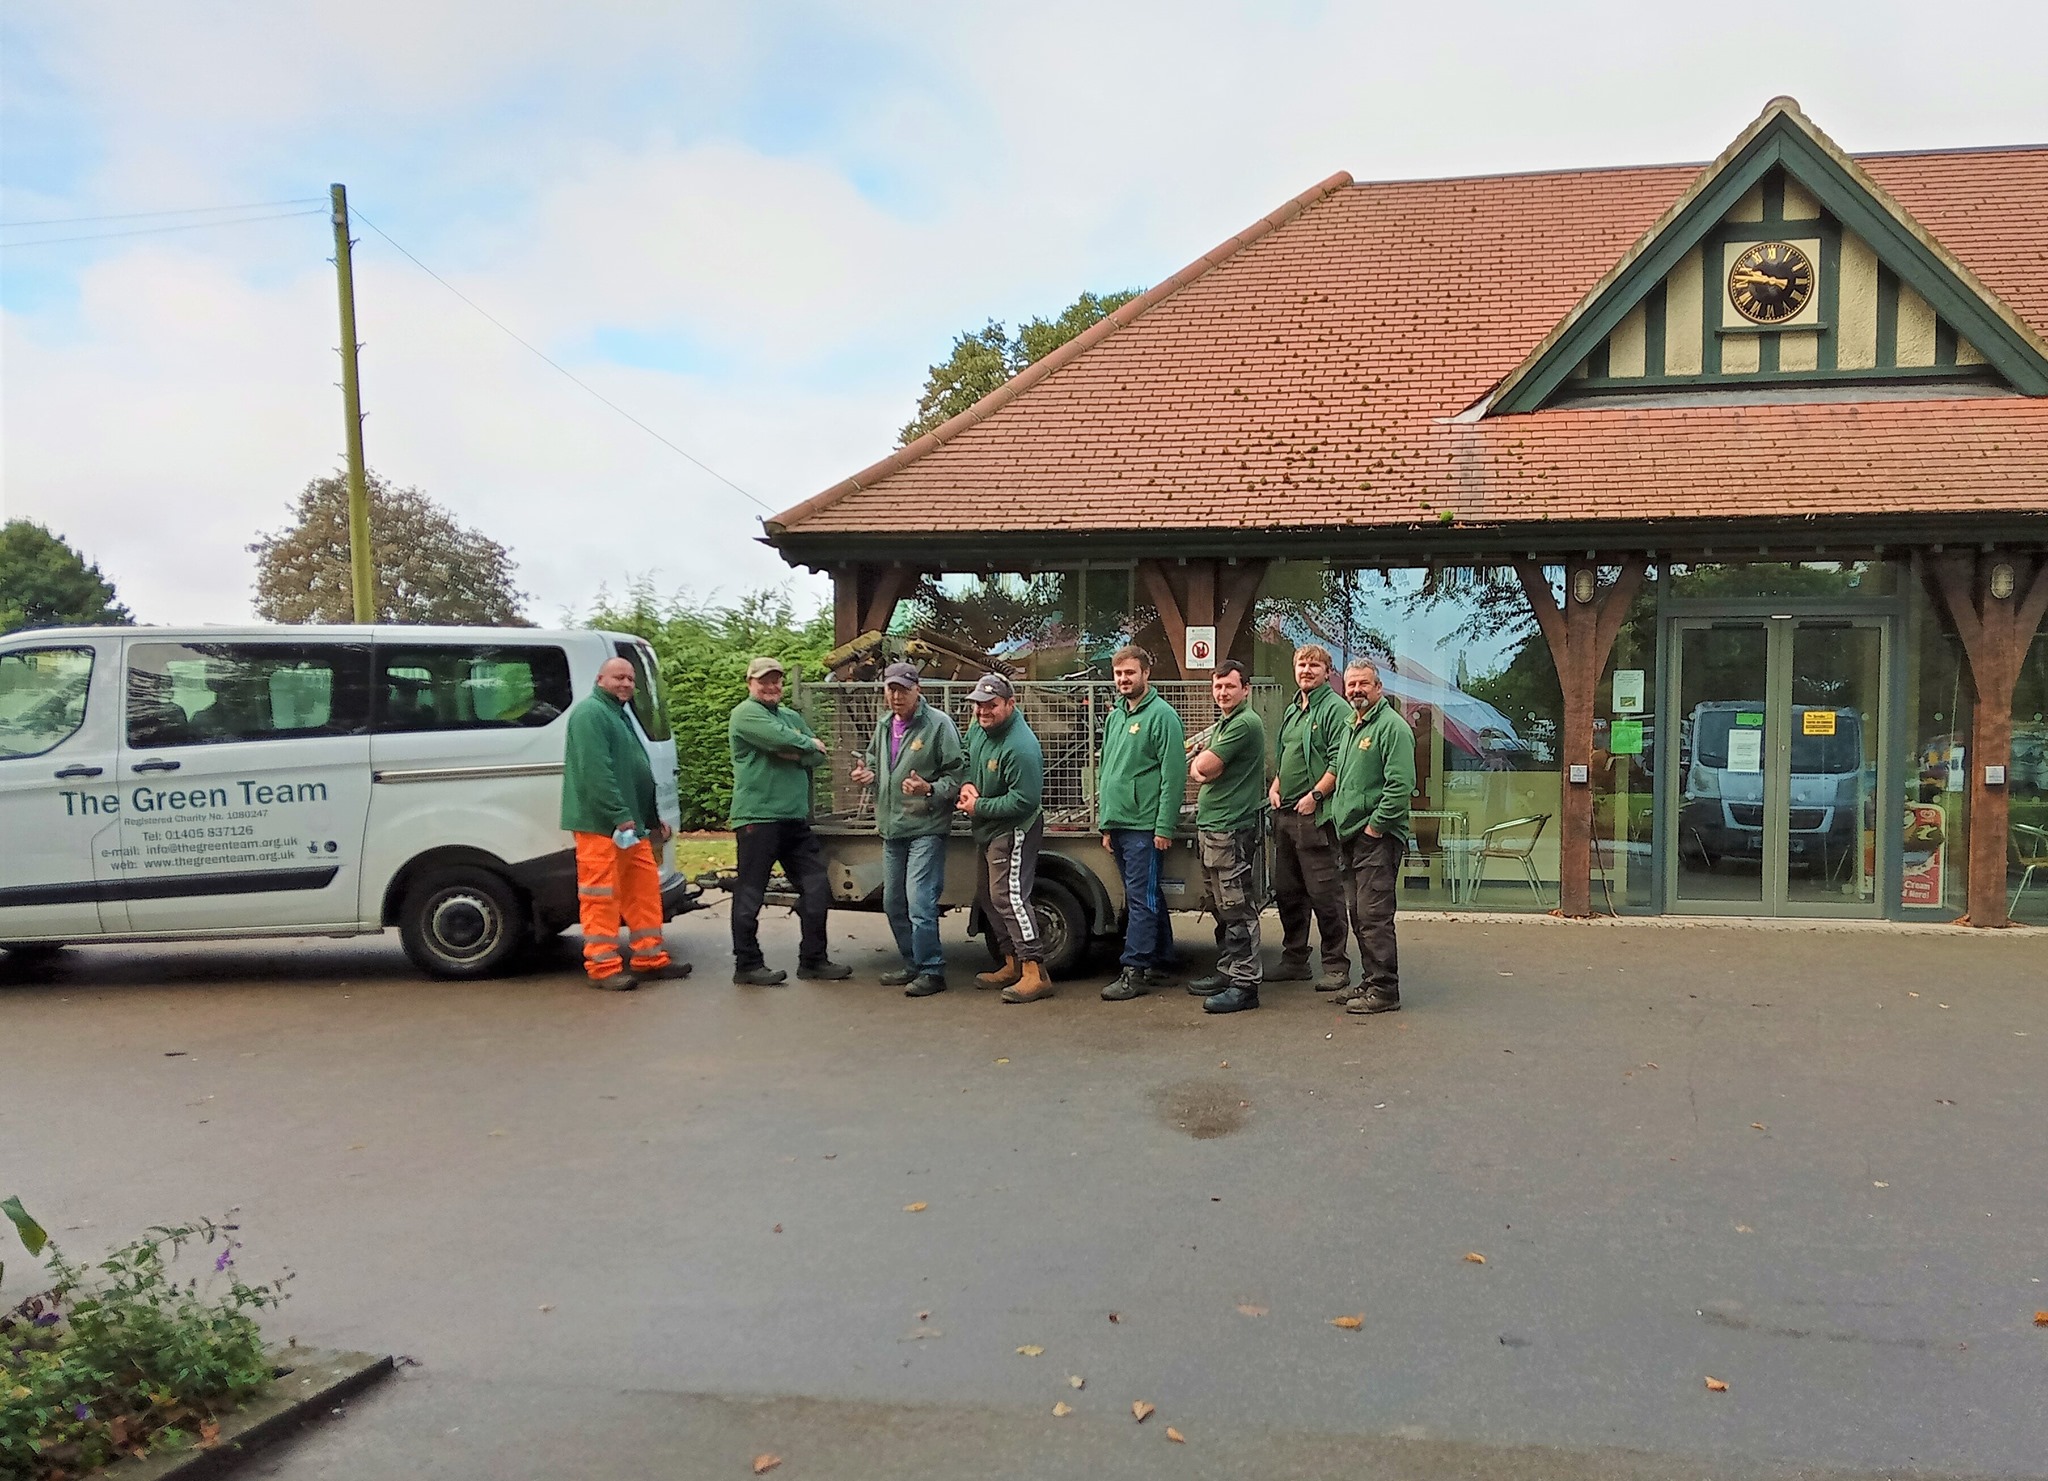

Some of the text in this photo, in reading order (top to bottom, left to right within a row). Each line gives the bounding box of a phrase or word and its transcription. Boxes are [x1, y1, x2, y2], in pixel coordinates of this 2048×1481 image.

[59, 780, 327, 816] The Green Team
[124, 809, 269, 827] Registered Charity No. 1080247
[101, 835, 298, 858] e-mail: info@thegreenteam.org.uk
[142, 831, 162, 842] Tel:
[110, 850, 296, 871] web: www.thegreenteam.org.uk
